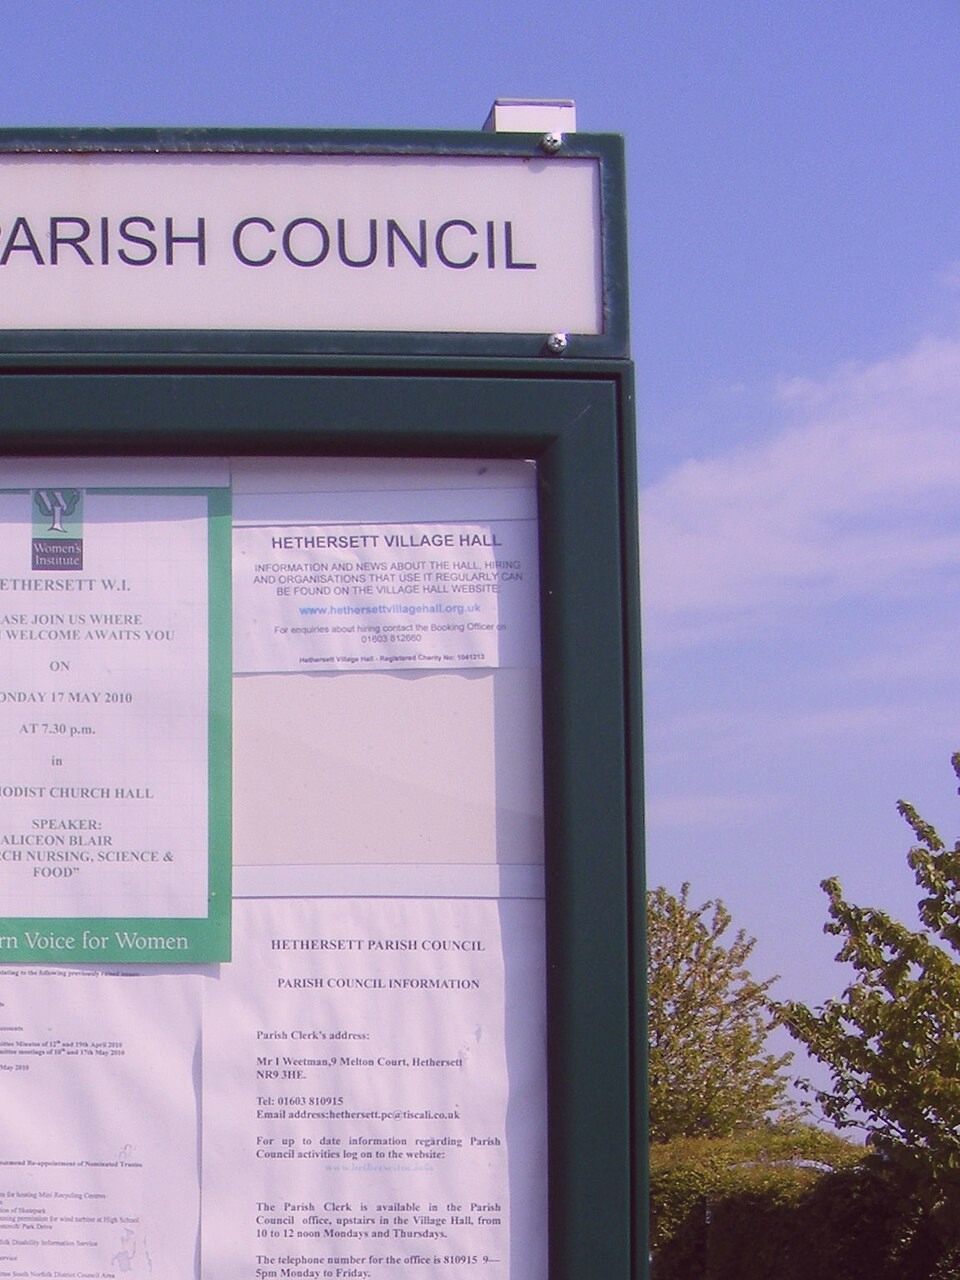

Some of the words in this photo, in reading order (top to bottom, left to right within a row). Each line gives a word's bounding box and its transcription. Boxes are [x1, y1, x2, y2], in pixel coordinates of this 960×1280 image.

[233, 217, 536, 269] COUNCIL
[33, 542, 82, 554] Women's
[271, 535, 380, 550] HETHERSETT
[383, 534, 455, 548] VILLAGE
[459, 534, 503, 547] HALL
[35, 554, 80, 566] Institute
[254, 561, 329, 573] INFORMATION
[330, 562, 354, 572] AND
[355, 561, 388, 572] NEWS
[389, 560, 427, 572] ABOUT
[428, 560, 450, 572] THE
[484, 560, 522, 570] HIRING
[253, 575, 277, 585] AND
[277, 573, 367, 585] ORGANISATIONS
[367, 573, 397, 583] THAT
[399, 573, 421, 583] USE
[423, 572, 433, 583] IT
[435, 572, 499, 582] REGULARLY
[501, 571, 523, 581] CAN
[101, 578, 131, 592] W.I.
[276, 586, 291, 597] BE
[293, 584, 332, 596] FOUND
[333, 583, 350, 596] ON
[350, 584, 374, 596] THE
[375, 583, 420, 595] VILLAGE
[422, 584, 450, 594] HALL
[298, 602, 481, 618] www.hethersettvillagehall.org.uk
[30, 614, 65, 626] JOIN
[68, 614, 86, 626] US
[89, 614, 143, 626] WHERE
[5, 629, 81, 641] WELCOME
[84, 629, 141, 641] AWAITS
[144, 630, 175, 641] YOU
[49, 660, 70, 672] ON
[51, 691, 65, 703] 17
[68, 691, 101, 704] MAY
[104, 692, 133, 704] 2010
[19, 722, 39, 734] AT
[41, 722, 67, 735] 7.30
[69, 726, 96, 738] p.m.
[50, 755, 63, 767] in
[49, 786, 111, 800] CHURCH
[115, 788, 154, 799] HALL
[31, 818, 102, 831] SPEAKER:
[0, 834, 65, 847] ALICEON
[68, 835, 113, 847] BLAIR
[97, 850, 159, 862] SCIENCE
[162, 851, 174, 862] &
[25, 932, 75, 949] Voice
[82, 931, 109, 949] for
[115, 932, 188, 949] Women
[271, 939, 364, 951] HETHERSETT
[367, 939, 418, 951] PARISH
[421, 940, 485, 952] COUNCIL
[277, 977, 324, 989] PARISH
[326, 978, 386, 989] COUNCIL
[388, 978, 480, 990] INFORMATION
[256, 1030, 288, 1040] Parish
[328, 1030, 370, 1040] address:
[256, 1056, 274, 1067] Mr
[339, 1056, 375, 1067] Melton
[376, 1057, 410, 1067] Court,
[412, 1057, 463, 1067] Hethersett
[256, 1069, 280, 1080] NR9
[257, 1096, 275, 1106] Tel:
[277, 1096, 307, 1106] 01603
[308, 1096, 344, 1106] 810915
[256, 1109, 286, 1119] Email
[256, 1135, 275, 1146] For
[281, 1138, 296, 1148] up
[302, 1137, 312, 1146] to
[319, 1136, 342, 1146] date
[348, 1135, 408, 1146] information
[414, 1136, 463, 1148] regarding
[470, 1136, 501, 1146] Parish
[256, 1202, 276, 1212] The
[283, 1202, 316, 1212] Parish
[323, 1201, 352, 1212] Clerk
[360, 1202, 368, 1212] is
[376, 1202, 421, 1212] available
[428, 1202, 438, 1212] in
[446, 1202, 462, 1212] the
[470, 1202, 501, 1212] Parish
[255, 1268, 278, 1280] 5pm
[280, 1268, 321, 1280] Monday
[323, 1269, 334, 1278] to
[335, 1267, 371, 1280] Friday.
